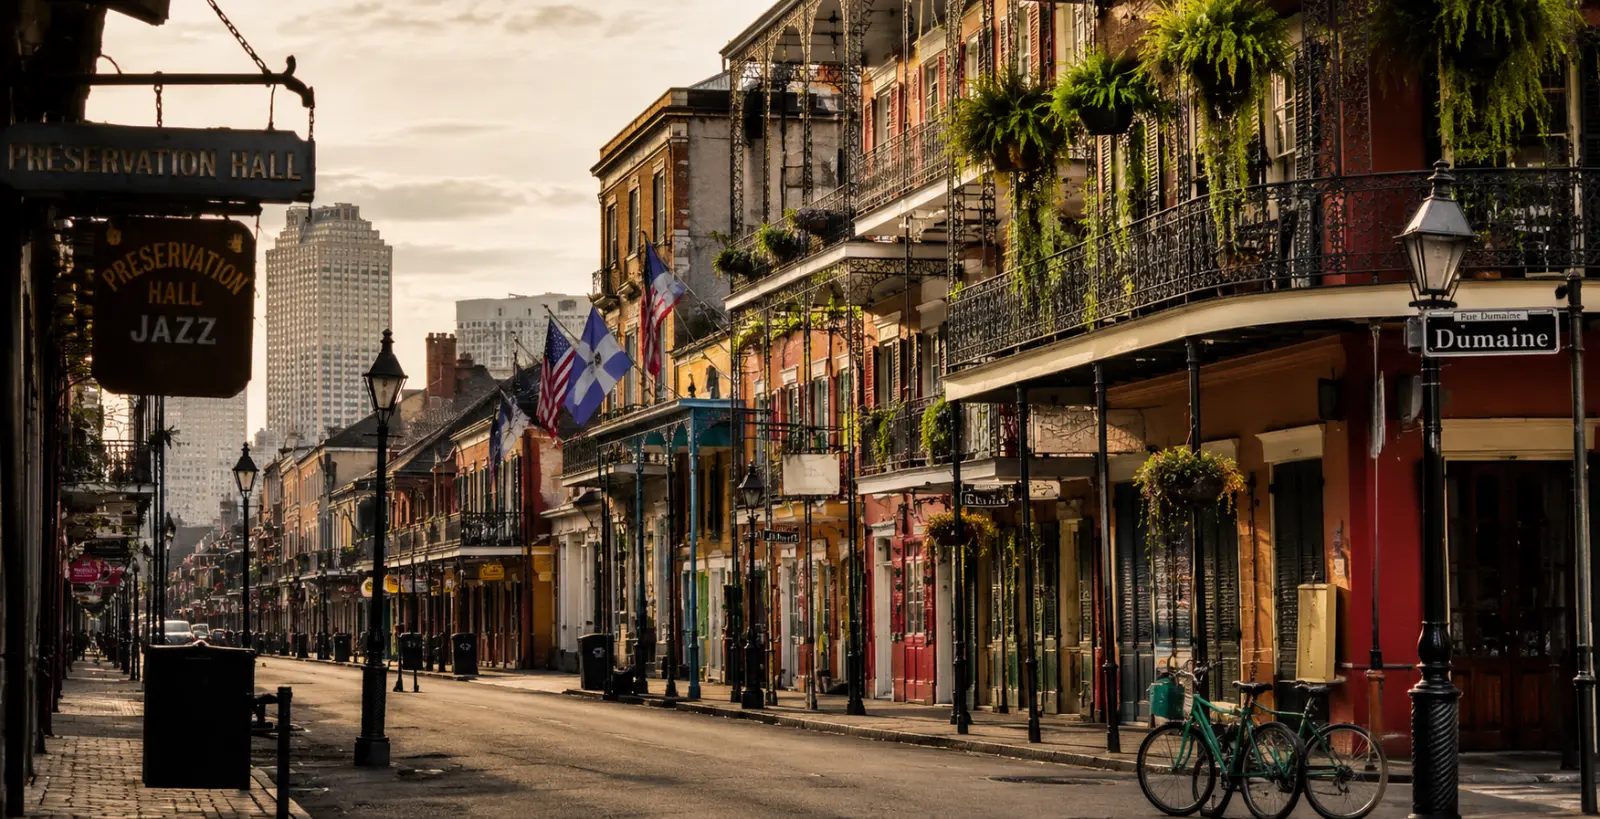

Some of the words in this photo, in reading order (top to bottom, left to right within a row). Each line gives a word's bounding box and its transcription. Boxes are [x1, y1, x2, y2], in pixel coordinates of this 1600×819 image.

[8, 143, 216, 178] PRESERVATION
[230, 150, 302, 181] HALL
[101, 242, 249, 296] PRESERVATION
[148, 281, 203, 306] HALL
[130, 314, 216, 345] JAZZ
[1480, 311, 1521, 321] Dumaine
[1434, 327, 1549, 349] Dumaine
